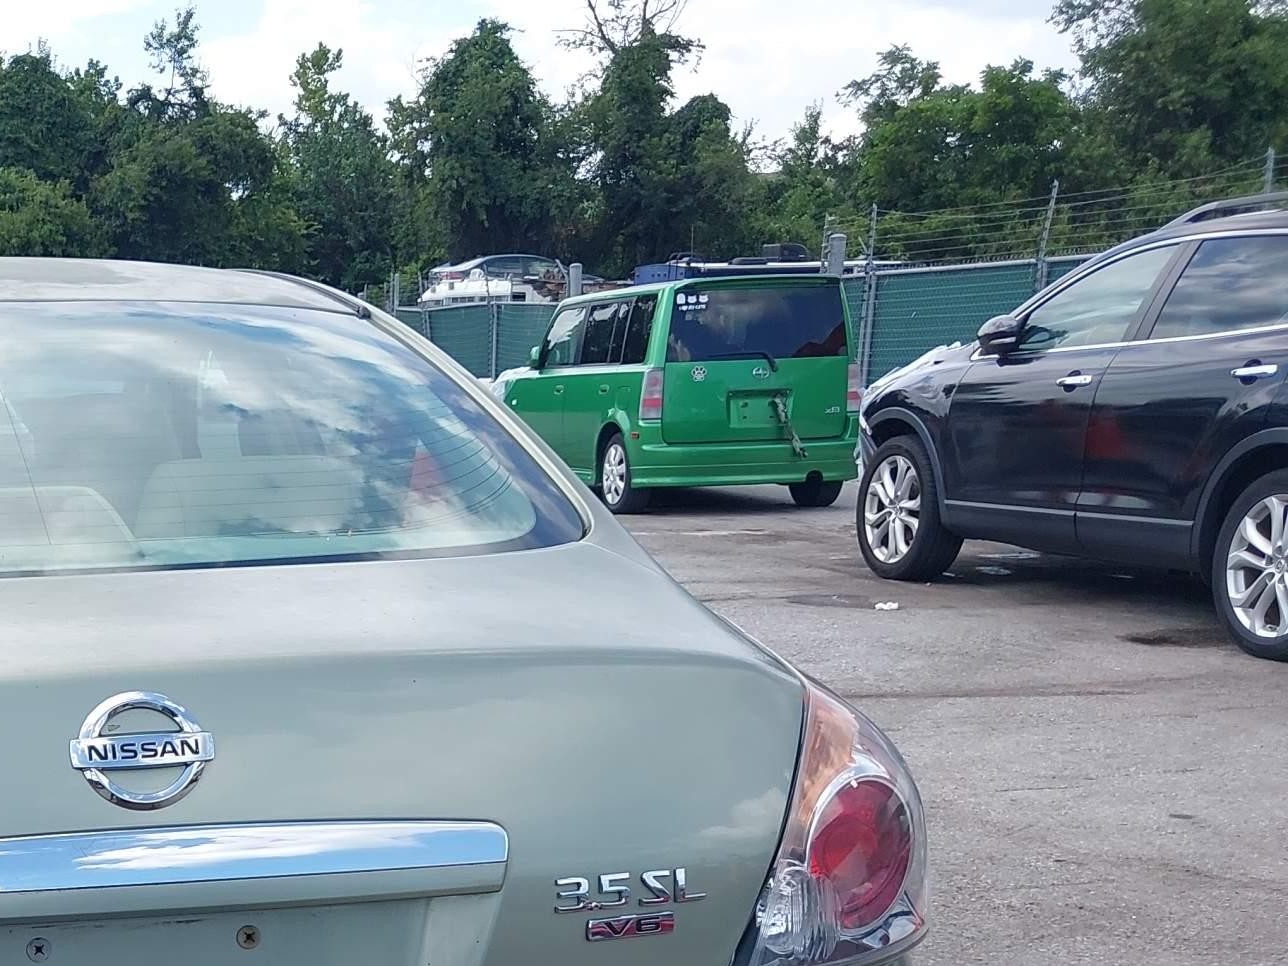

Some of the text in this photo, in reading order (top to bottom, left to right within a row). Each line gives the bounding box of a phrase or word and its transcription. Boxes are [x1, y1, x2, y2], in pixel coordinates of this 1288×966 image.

[87, 739, 200, 762] NISSAN
[638, 866, 708, 907] SL
[604, 916, 662, 937] V6
